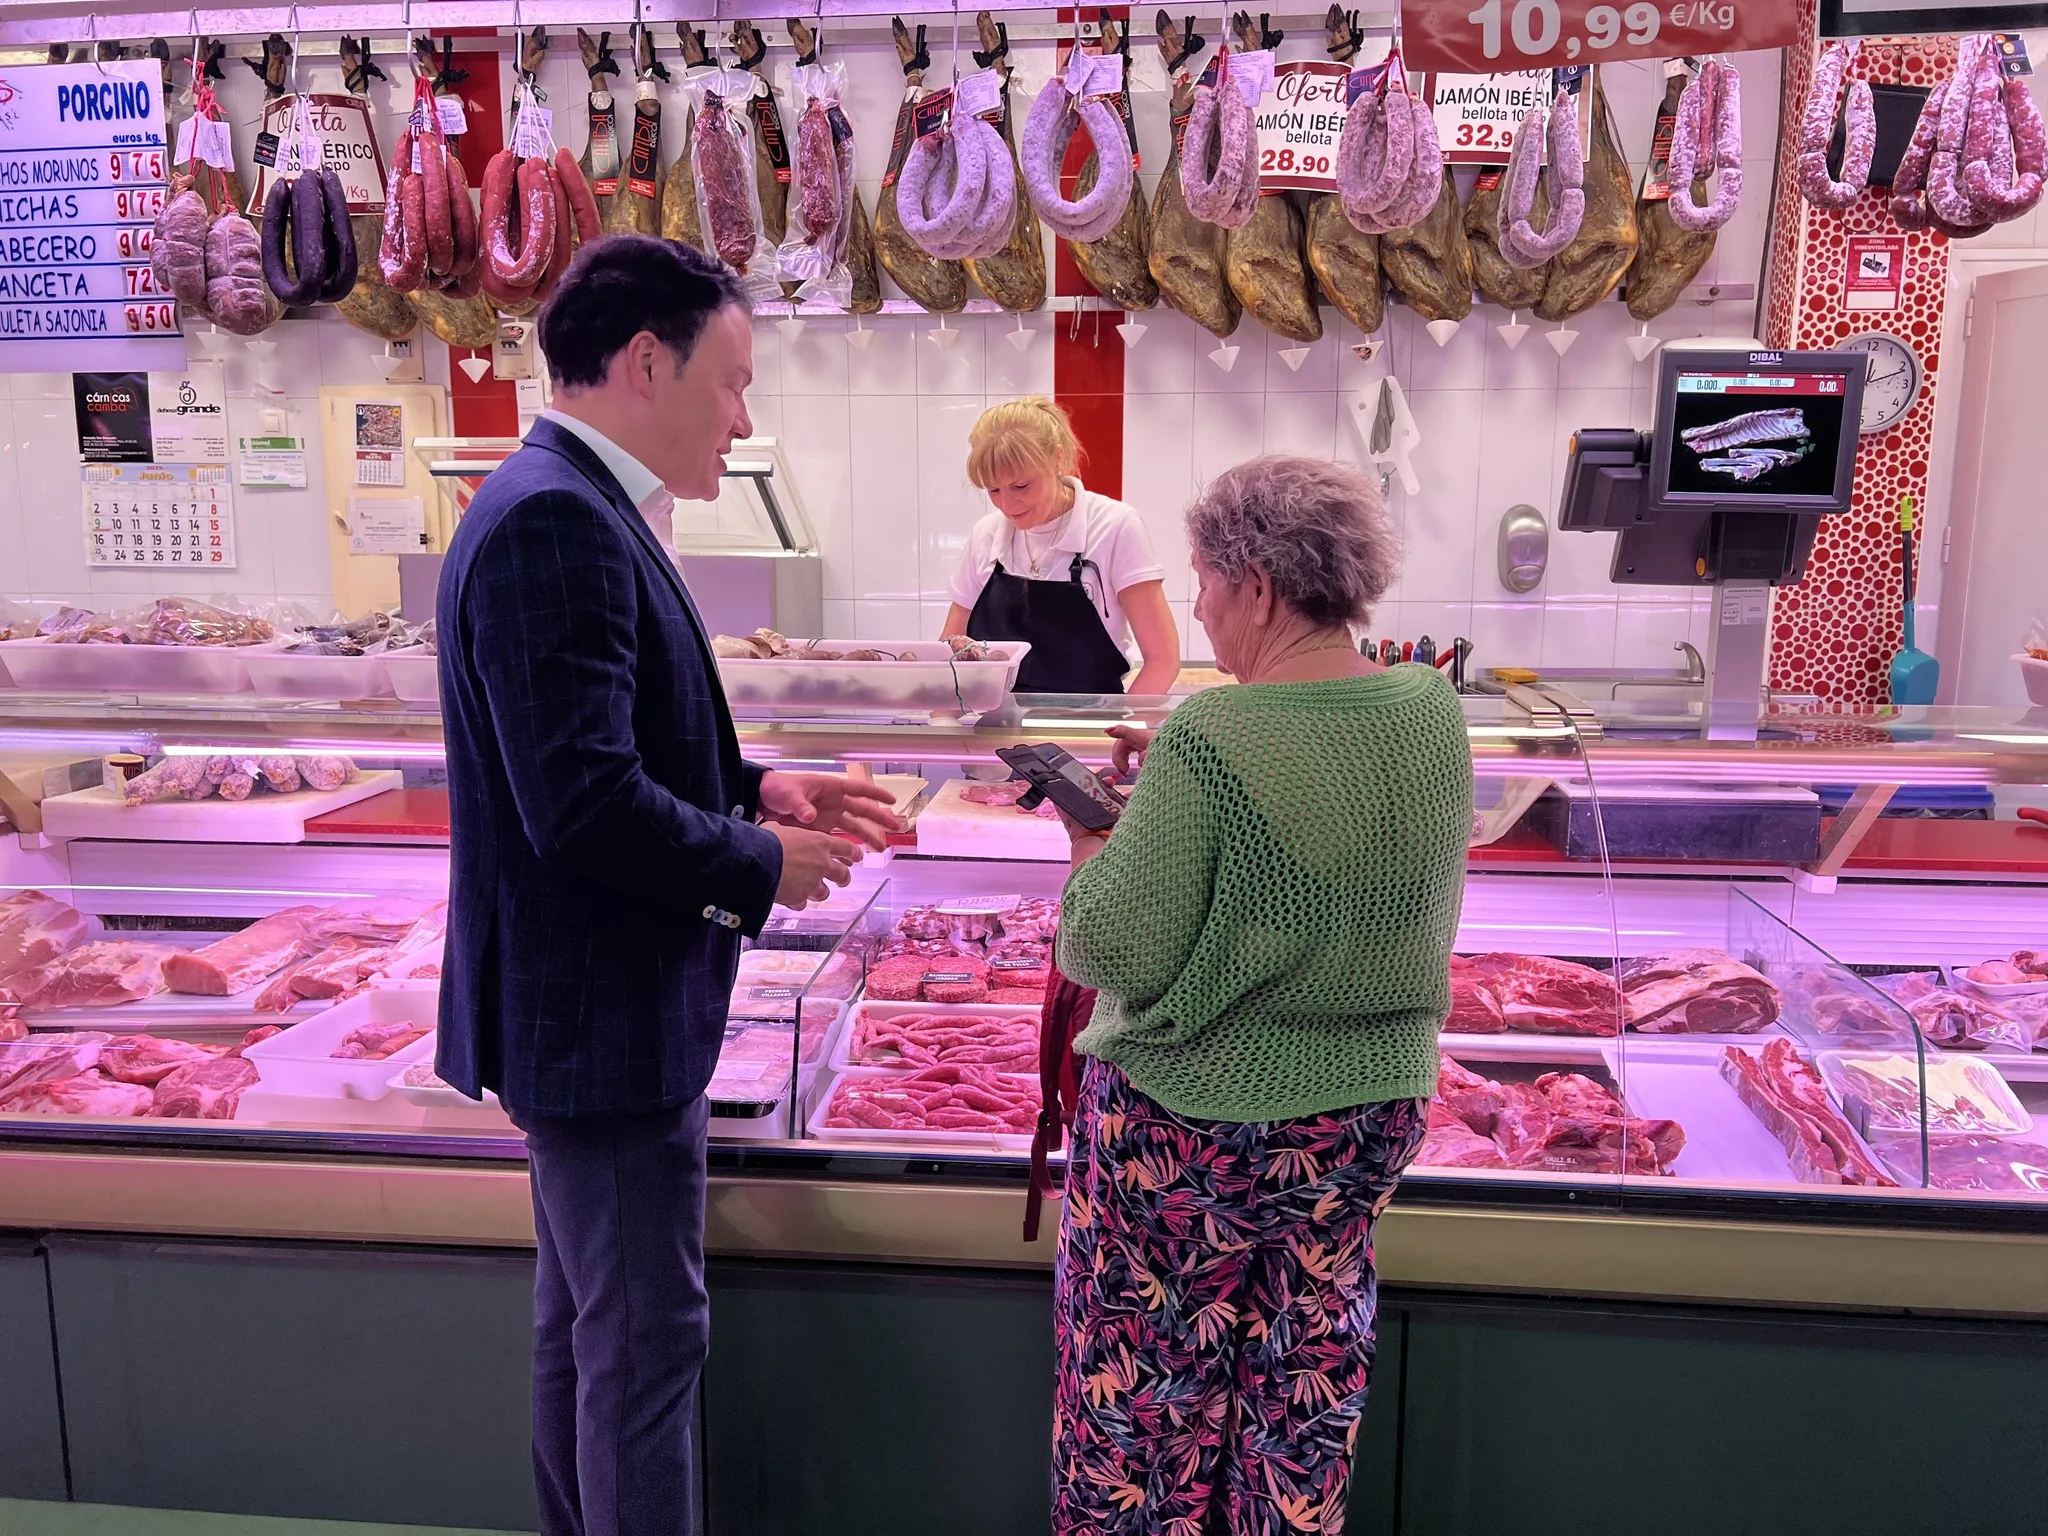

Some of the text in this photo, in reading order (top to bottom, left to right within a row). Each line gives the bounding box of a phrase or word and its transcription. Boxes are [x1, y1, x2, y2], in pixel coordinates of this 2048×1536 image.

[1467, 0, 1735, 60] 10,99 €/Kg
[1277, 71, 1347, 107] Ofert
[1435, 83, 1500, 105] JAMÓN
[58, 80, 151, 122] PORCINO
[1255, 109, 1304, 131] AMÓN
[1462, 106, 1507, 121] bellota
[112, 133, 142, 144] euros
[1286, 130, 1332, 146] bellota
[1456, 124, 1513, 150] 32,9
[322, 139, 373, 159] ÉRICO
[633, 116, 653, 174] CAMBA
[1260, 149, 1330, 174] 28,90
[32, 158, 100, 184] MORUNOS
[0, 194, 79, 222] ICHAS
[0, 304, 171, 334] ULETA SAJONIA 950
[1867, 341, 1879, 351] 12
[1889, 347, 1893, 356] 1
[1749, 352, 1783, 361] DIBAL
[1899, 361, 1906, 370] 2
[1902, 379, 1909, 389] 3
[87, 402, 126, 412] camba
[1892, 397, 1899, 407] 4
[177, 403, 221, 416] grande
[1877, 411, 1885, 420] 5
[138, 471, 174, 481] Junio
[210, 488, 215, 499] 1
[94, 503, 217, 515] 2 3 4 5 6 7 8
[94, 518, 219, 530] 9 10 11 12 13 14 15
[94, 533, 221, 546] 16 17 18 19 20 21 22
[115, 549, 126, 561] 24
[134, 550, 145, 561] 25
[153, 550, 164, 561] 26
[171, 550, 182, 562] 27
[191, 550, 203, 562] 28
[211, 551, 222, 562] 29
